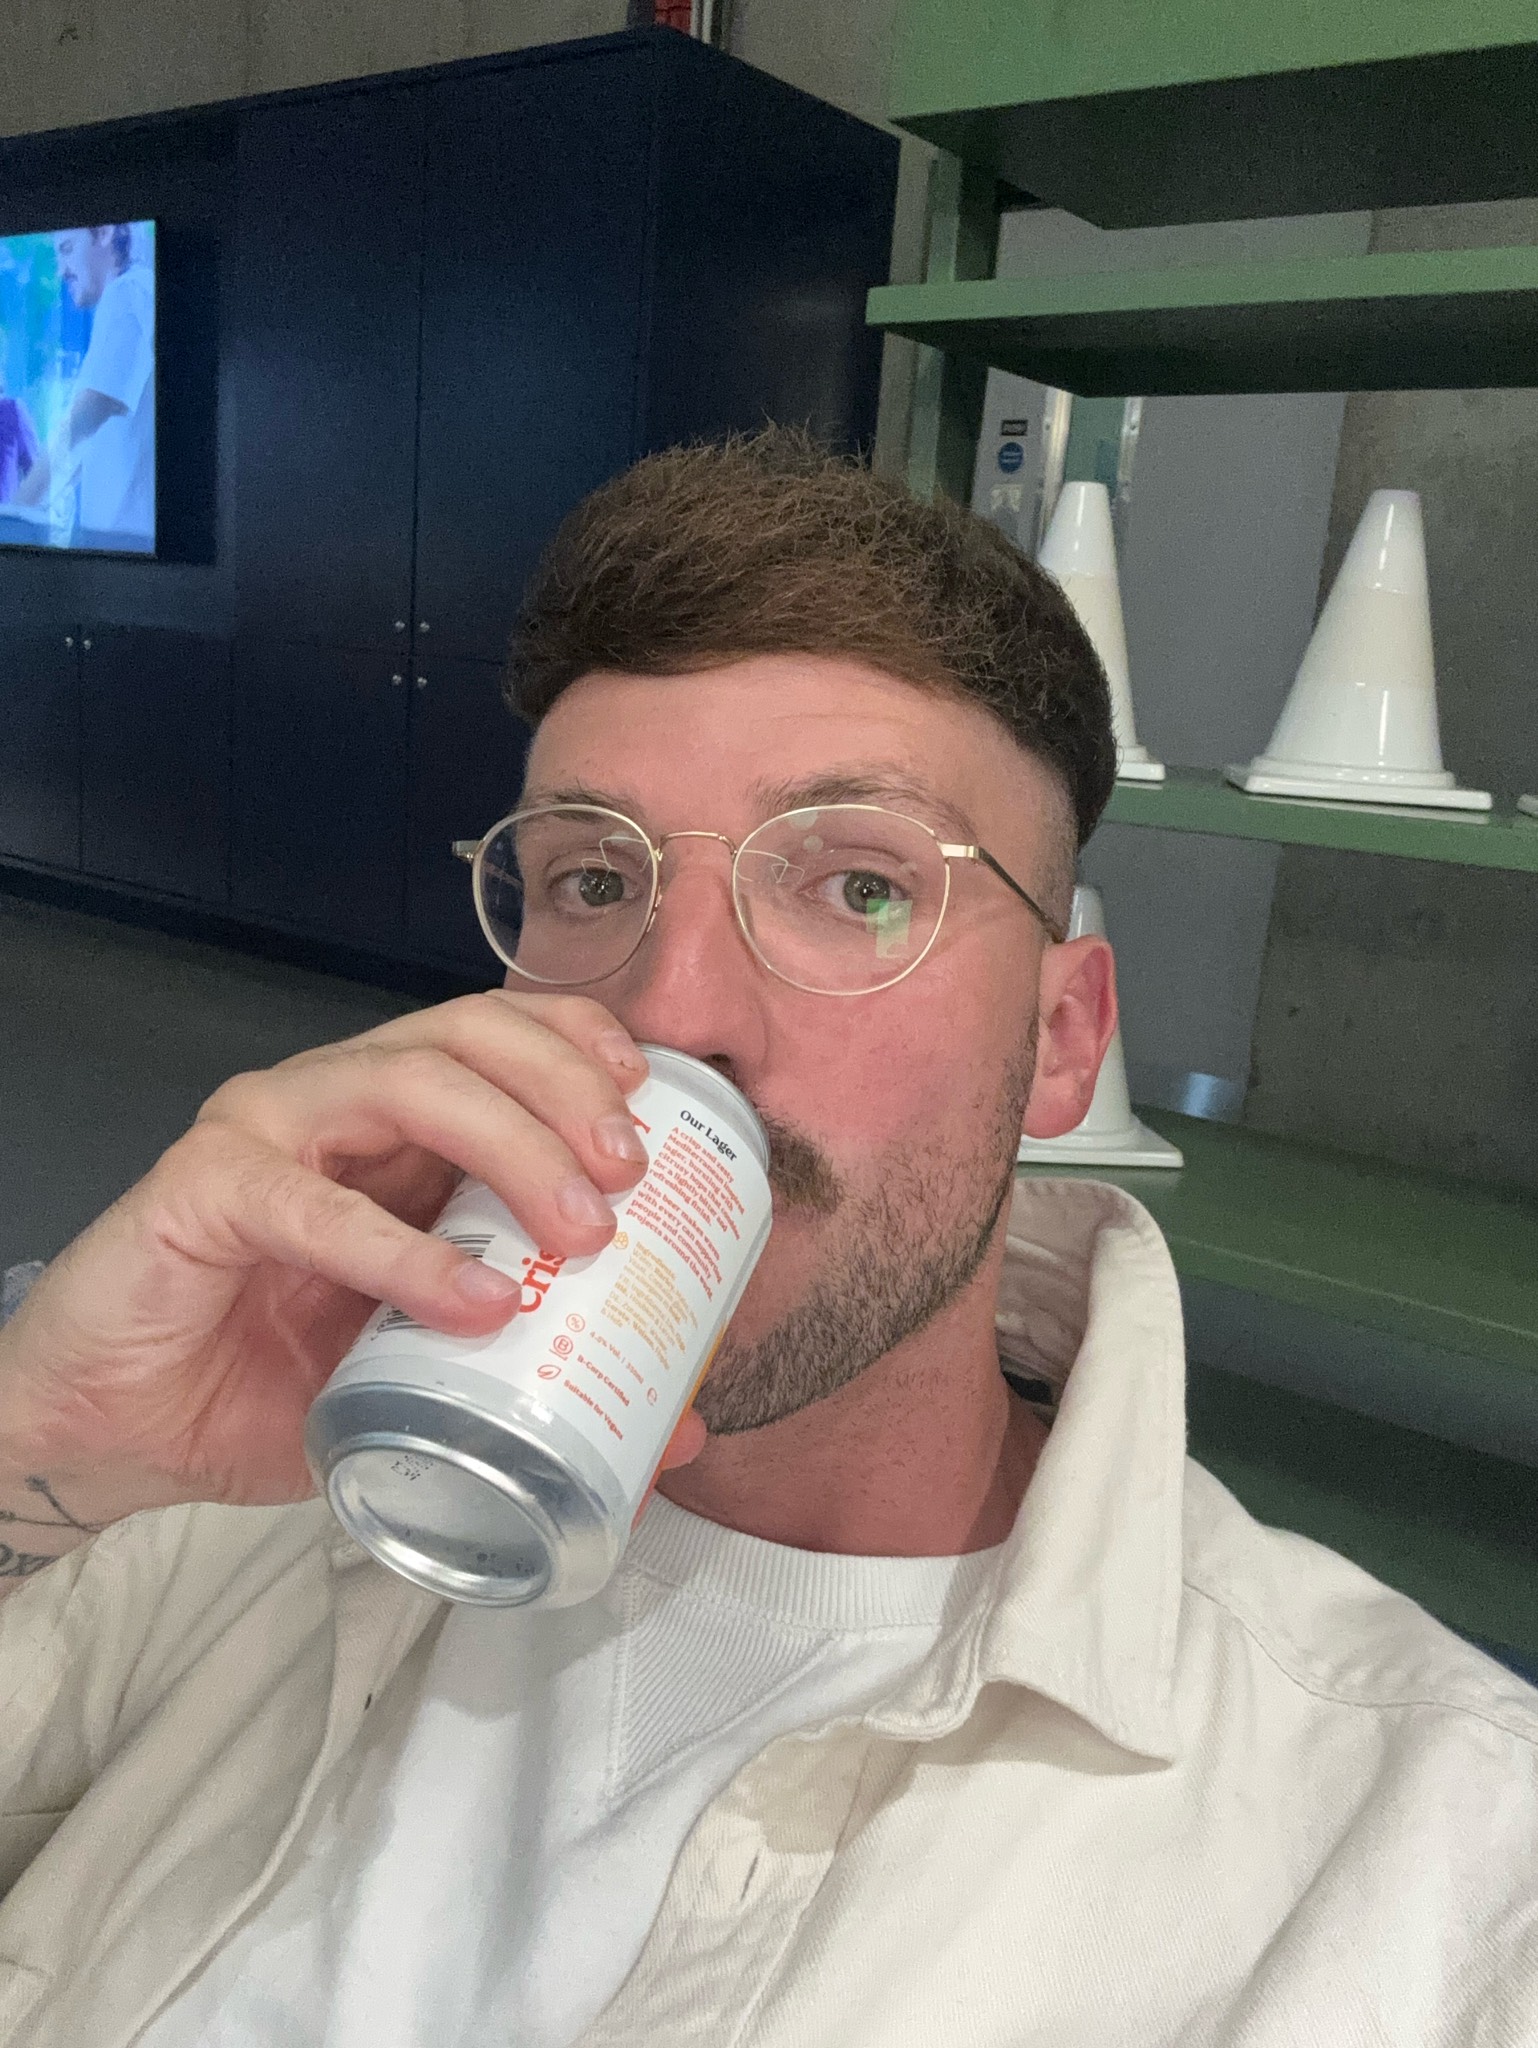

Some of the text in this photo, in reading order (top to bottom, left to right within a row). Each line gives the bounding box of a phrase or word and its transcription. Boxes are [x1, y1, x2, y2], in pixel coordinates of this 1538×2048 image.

[680, 1110, 705, 1131] Our
[705, 1127, 737, 1161] Lager
[680, 1132, 702, 1150] crisp
[701, 1148, 717, 1163] and
[716, 1163, 734, 1183] zesty
[649, 1169, 711, 1226] refreshing finish.
[653, 1159, 667, 1170] for
[674, 1173, 699, 1197] lightly
[699, 1194, 717, 1217] bitter
[716, 1216, 728, 1232] and
[658, 1152, 689, 1176] citrusy
[689, 1173, 708, 1193] hops
[707, 1191, 721, 1209] that
[663, 1142, 733, 1211] lager, bursting with
[668, 1134, 745, 1215] Mediterranean inspired
[626, 1208, 663, 1237] projects
[663, 1235, 690, 1263] around
[689, 1261, 700, 1277] the
[631, 1199, 712, 1280] people and community
[638, 1191, 722, 1285] with every can supporting
[643, 1180, 720, 1261] This beer makes waves
[557, 1338, 569, 1351] B
[564, 1380, 623, 1440] Suitable for Vegans
[577, 1355, 630, 1407] B-Corp Certified
